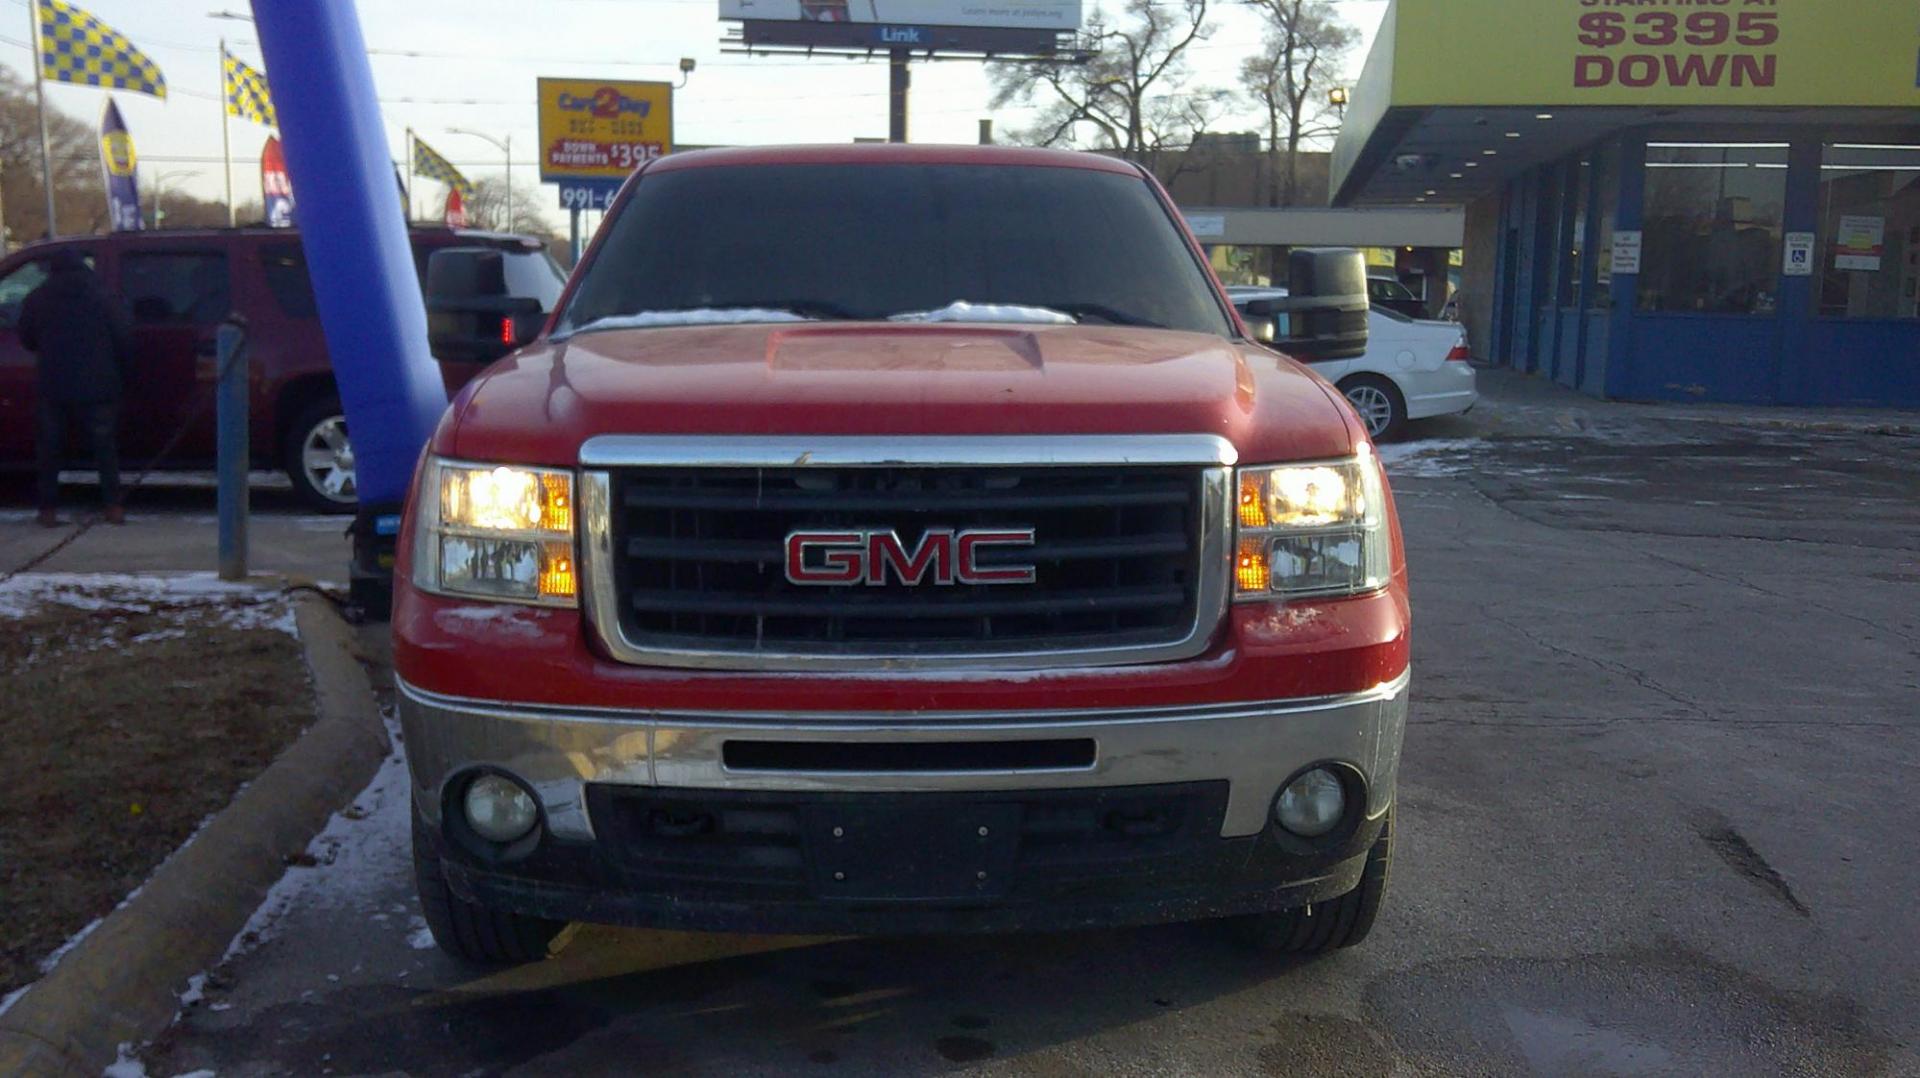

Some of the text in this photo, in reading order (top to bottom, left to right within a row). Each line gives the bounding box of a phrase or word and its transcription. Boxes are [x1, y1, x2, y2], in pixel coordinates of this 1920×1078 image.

[881, 27, 919, 42] Link
[1577, 11, 1780, 48] $395
[1573, 54, 1777, 88] DOWN
[552, 153, 608, 165] PAYMENTS
[784, 528, 1036, 586] GMC
